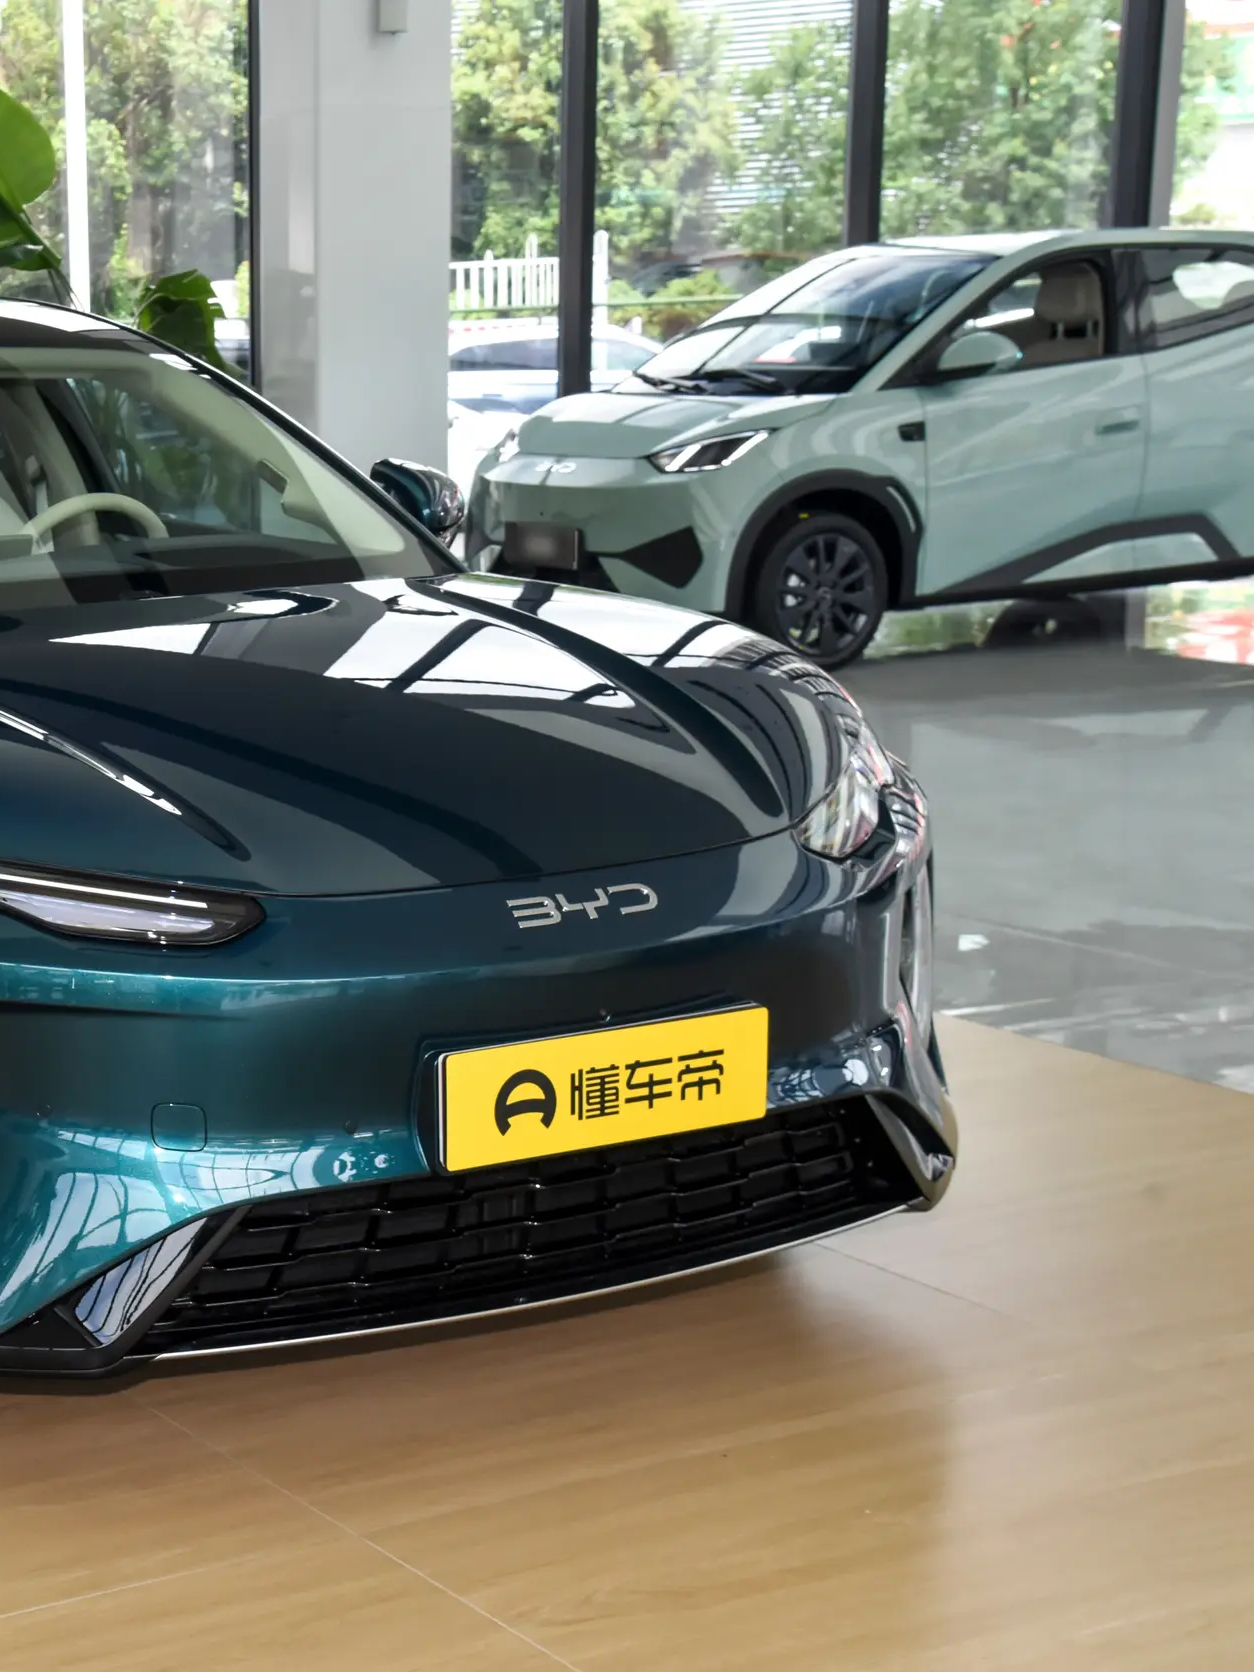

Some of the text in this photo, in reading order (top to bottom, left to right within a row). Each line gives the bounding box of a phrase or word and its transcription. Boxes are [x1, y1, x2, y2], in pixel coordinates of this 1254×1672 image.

[506, 883, 658, 928] BYD
[570, 1049, 725, 1120] 懂车帝
